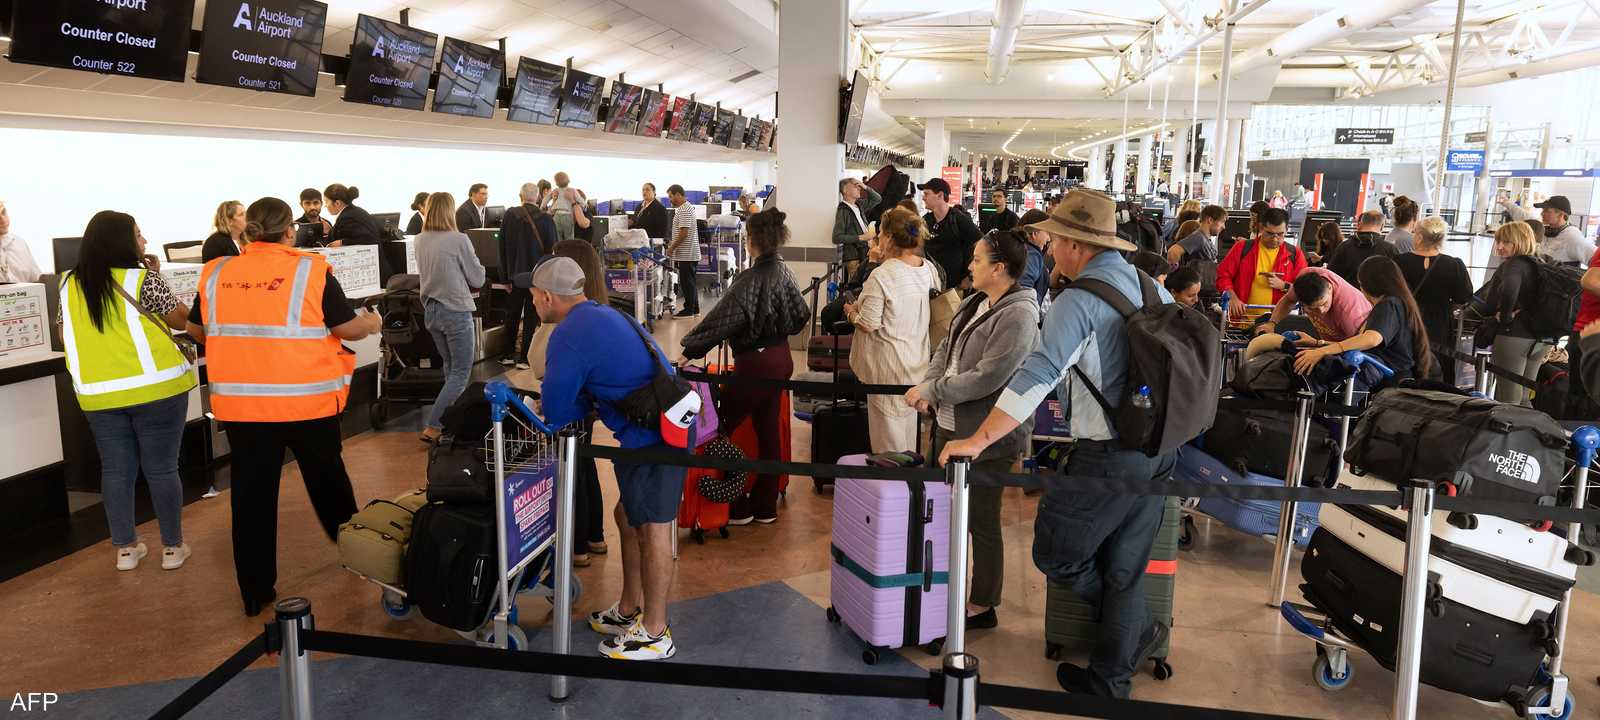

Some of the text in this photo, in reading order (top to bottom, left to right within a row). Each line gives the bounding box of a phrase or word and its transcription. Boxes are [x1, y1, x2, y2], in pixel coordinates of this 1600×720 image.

[259, 7, 304, 28] Auckland
[61, 22, 156, 49] Counter Closed
[257, 21, 291, 38] Airport
[72, 55, 136, 73] Counter 522
[232, 49, 297, 69] Counter Closed
[238, 75, 281, 90] Counter 521
[1488, 453, 1525, 471] NORTH
[1509, 449, 1527, 463] THE
[1496, 464, 1522, 479] FACE
[513, 488, 532, 513] ROLL
